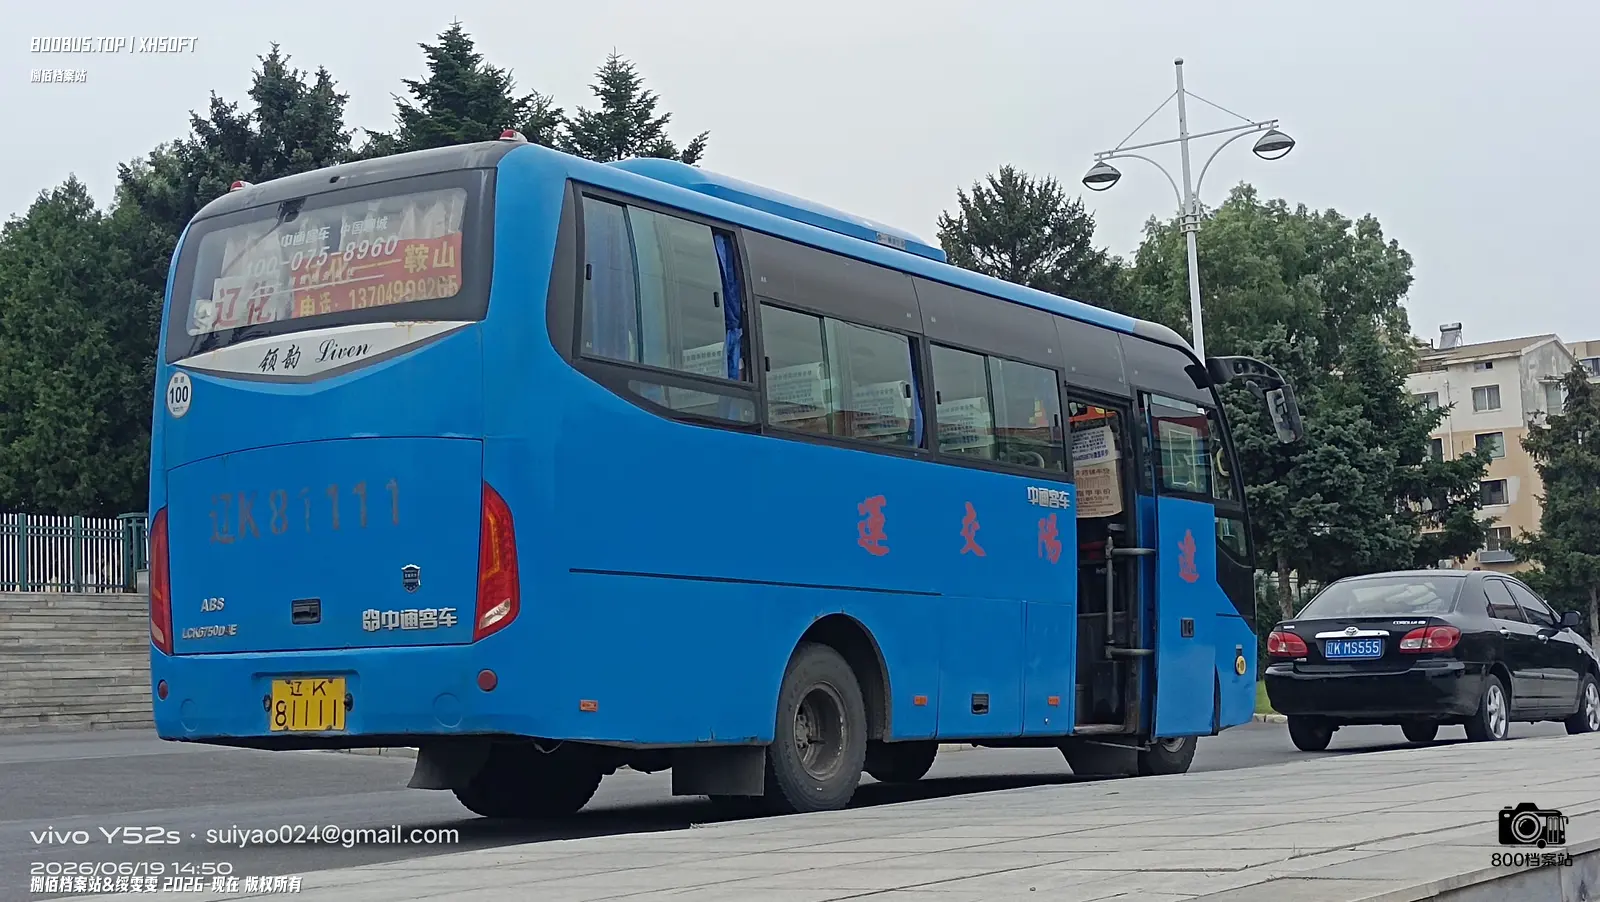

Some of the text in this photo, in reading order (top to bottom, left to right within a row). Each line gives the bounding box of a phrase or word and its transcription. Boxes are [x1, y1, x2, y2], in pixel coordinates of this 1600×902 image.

[403, 241, 456, 274] 鞍山
[314, 338, 373, 363] Liven
[169, 385, 189, 404] 100
[1026, 486, 1071, 510] 中通客车
[199, 597, 225, 613] ABS
[381, 607, 458, 631] 中通客车
[1343, 640, 1380, 654] MS555
[275, 699, 337, 727] 81111
